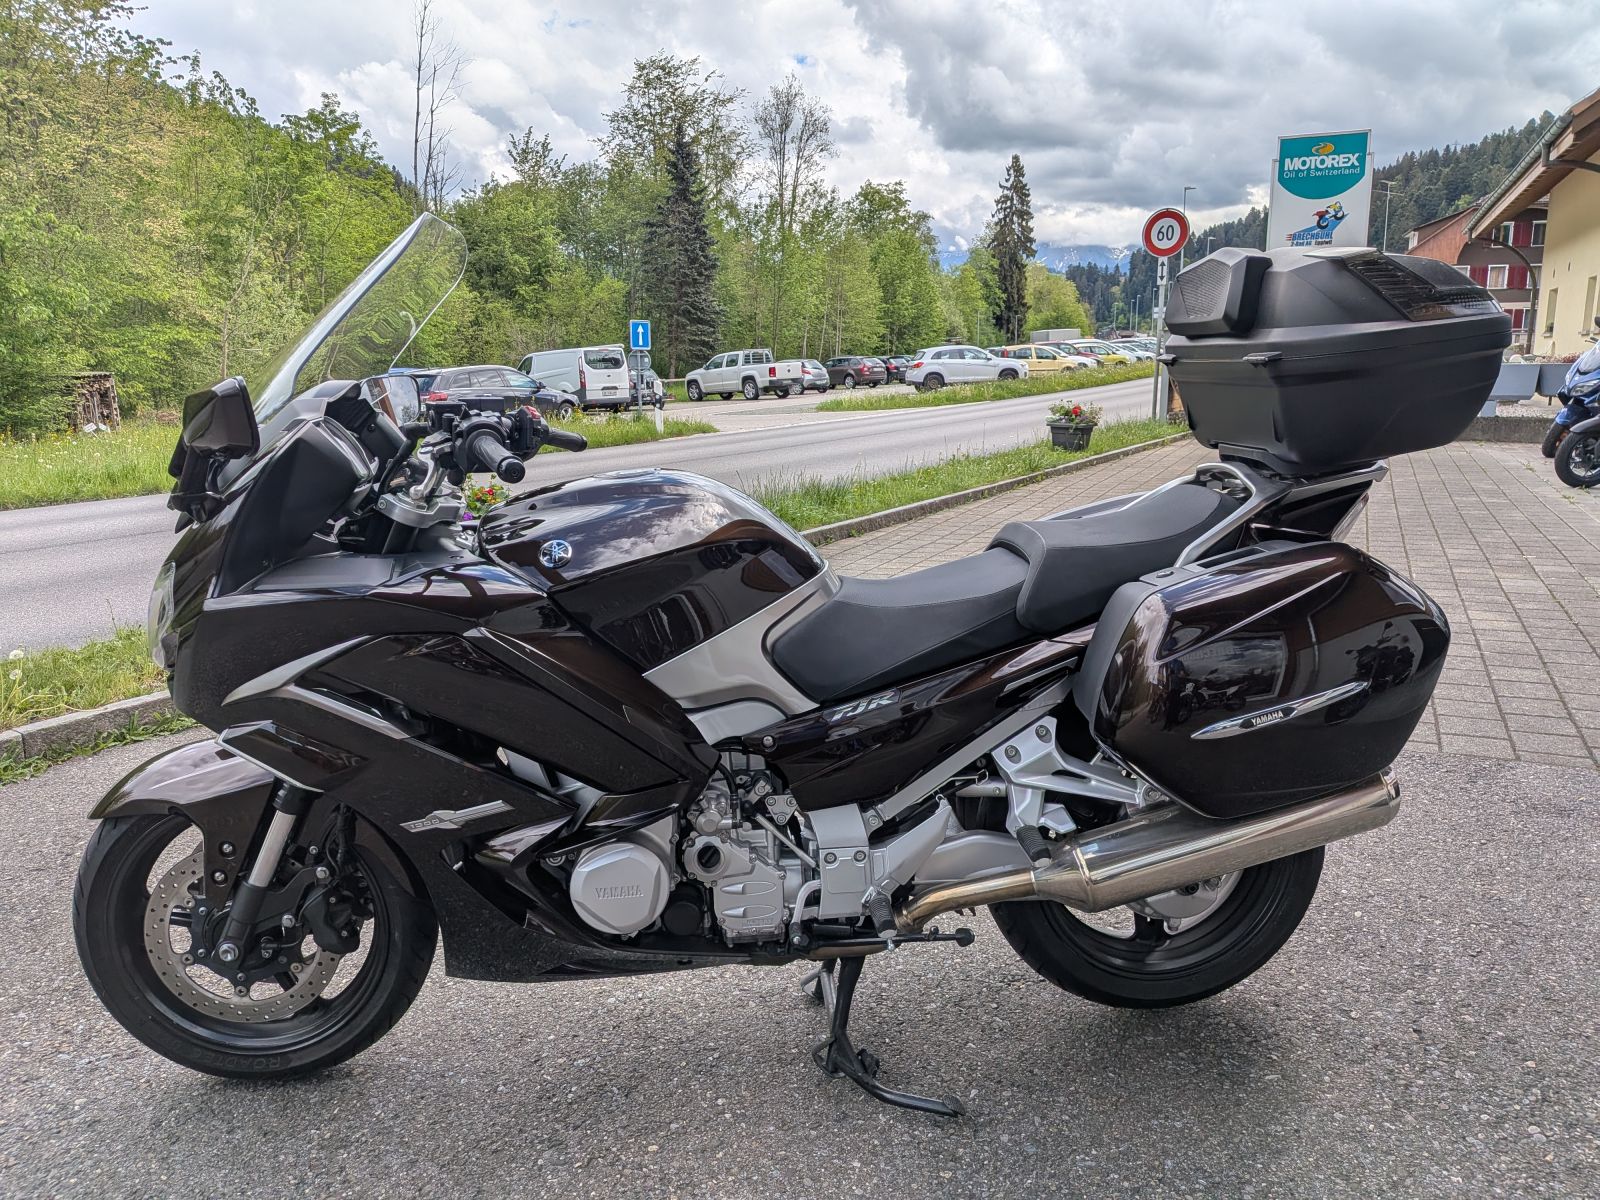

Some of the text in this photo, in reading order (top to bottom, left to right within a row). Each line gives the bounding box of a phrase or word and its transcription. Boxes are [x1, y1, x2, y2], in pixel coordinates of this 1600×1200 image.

[1284, 153, 1360, 171] MOTOREX
[1283, 167, 1360, 179] Oil of Switzerland
[1157, 224, 1175, 242] 60
[1250, 709, 1284, 726] YAMAHA
[594, 884, 644, 900] YAMAHA
